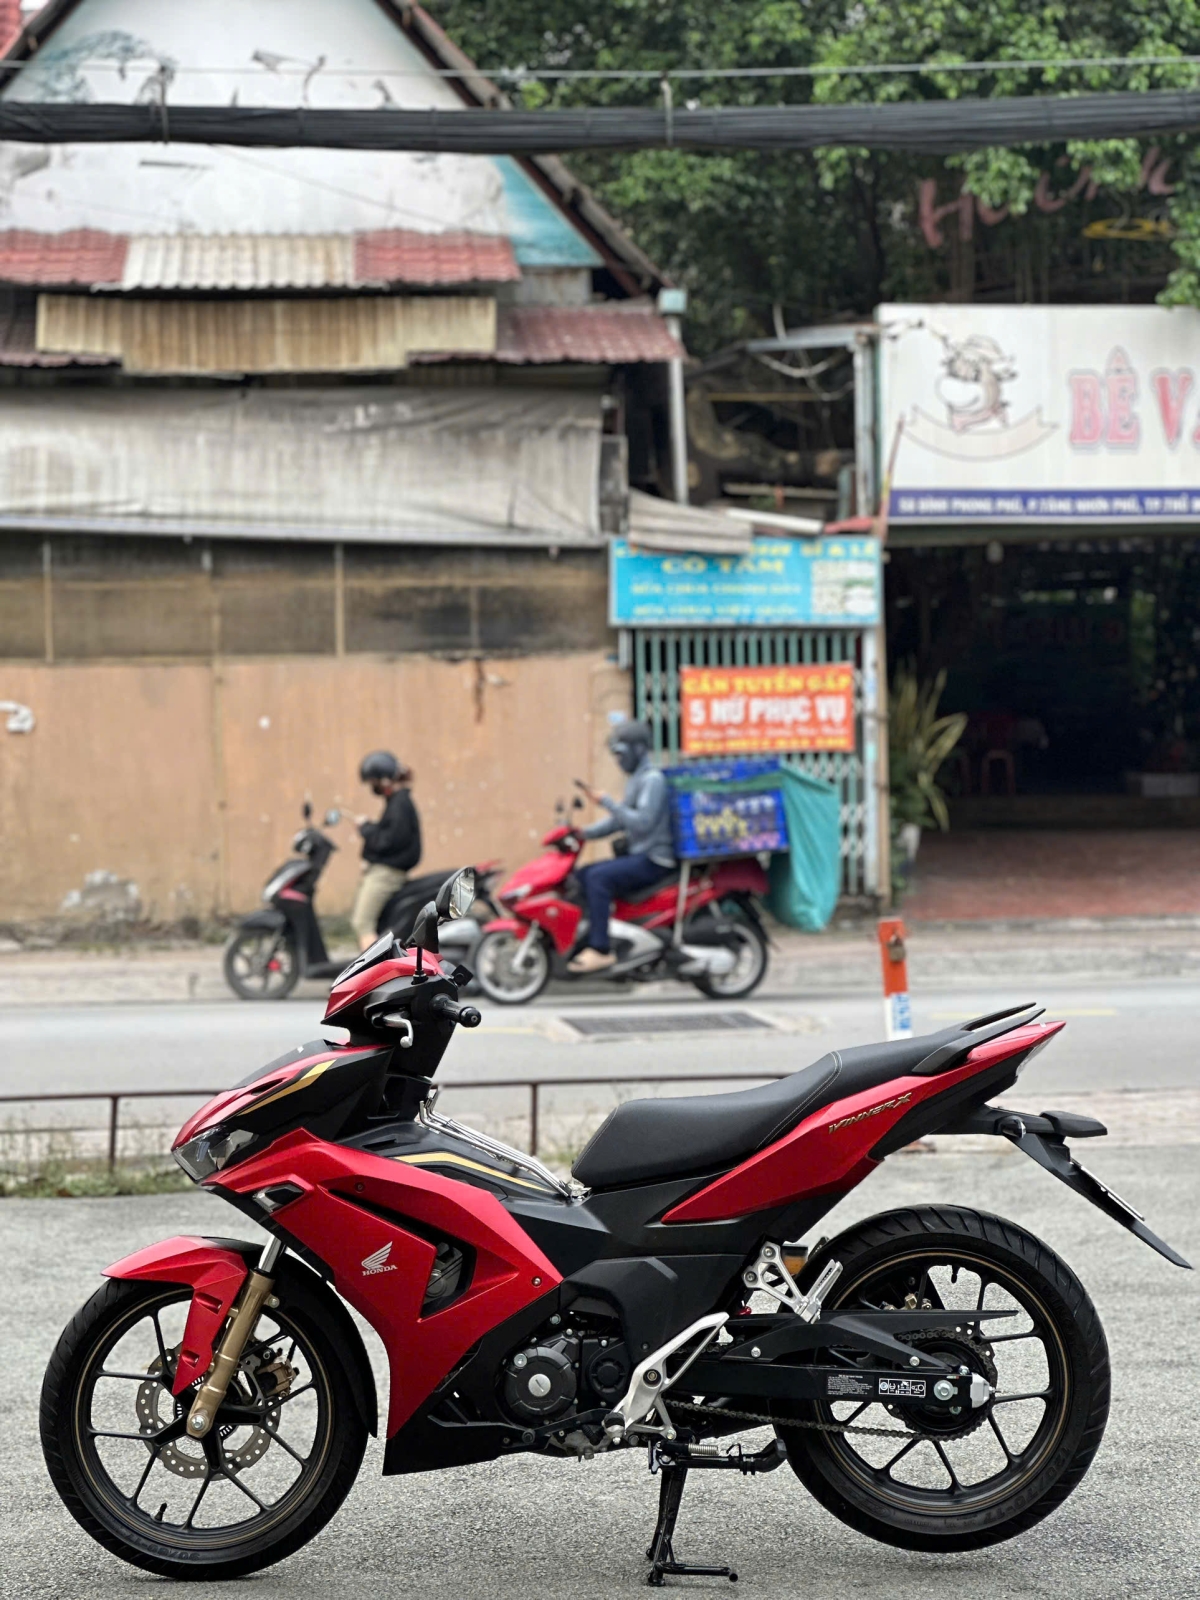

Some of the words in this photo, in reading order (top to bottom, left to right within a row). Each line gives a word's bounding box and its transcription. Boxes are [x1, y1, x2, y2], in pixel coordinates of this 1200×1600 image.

[1069, 349, 1138, 446] BÊ
[1154, 373, 1200, 444] V
[951, 497, 993, 514] PHONG
[690, 699, 706, 725] 5
[711, 694, 747, 725] NỮ
[750, 696, 812, 727] PHỤC
[815, 695, 846, 728] VỤ
[829, 1100, 895, 1133] WINNER
[893, 1092, 912, 1108] X
[362, 1264, 398, 1276] HONDA
